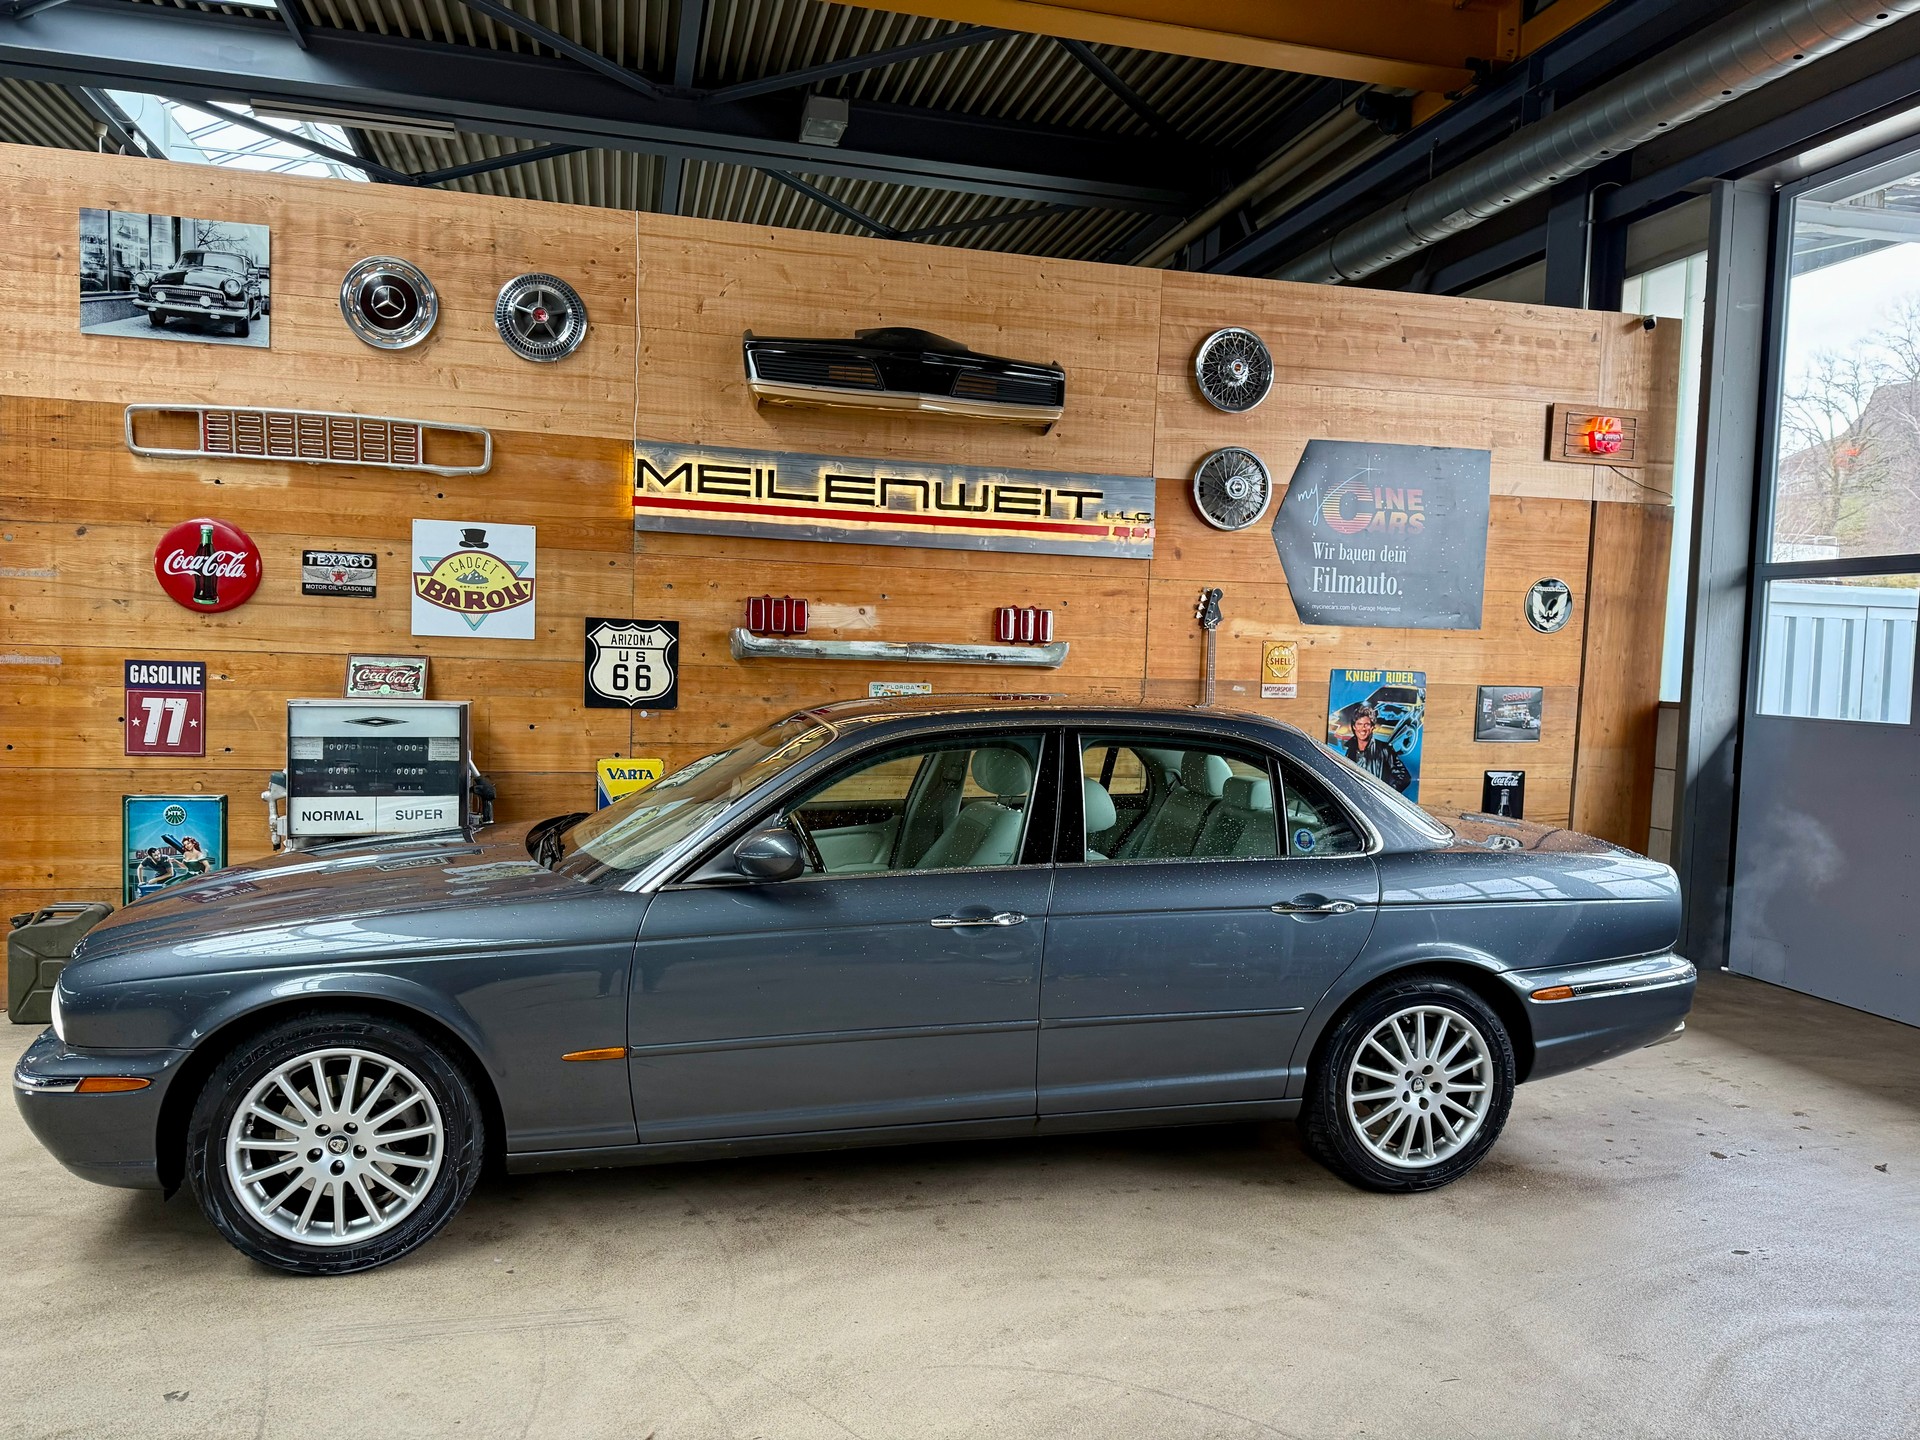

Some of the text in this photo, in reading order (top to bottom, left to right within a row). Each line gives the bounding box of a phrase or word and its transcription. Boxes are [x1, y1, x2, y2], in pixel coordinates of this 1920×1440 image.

[636, 458, 1104, 519] MEILENWEIT
[1297, 483, 1320, 526] my
[306, 554, 374, 568] TEXACO
[1312, 541, 1408, 563] Wir bauen dein
[163, 548, 249, 578] Coca-Cola
[449, 556, 500, 575] GADGET
[1311, 566, 1403, 596] Filmauto.
[421, 578, 529, 610] BARON
[610, 633, 653, 646] ARIZONA
[1270, 657, 1292, 665] SHELL
[129, 664, 201, 685] GASOLINE
[356, 669, 419, 684] Coca-Cola
[612, 664, 651, 691] 66
[1345, 670, 1413, 684] KNIGHT RIDER
[1503, 691, 1531, 701] OSRAM
[141, 697, 189, 746] 77
[606, 767, 654, 780] VARTA
[302, 809, 443, 821] NORMAL SUPER
